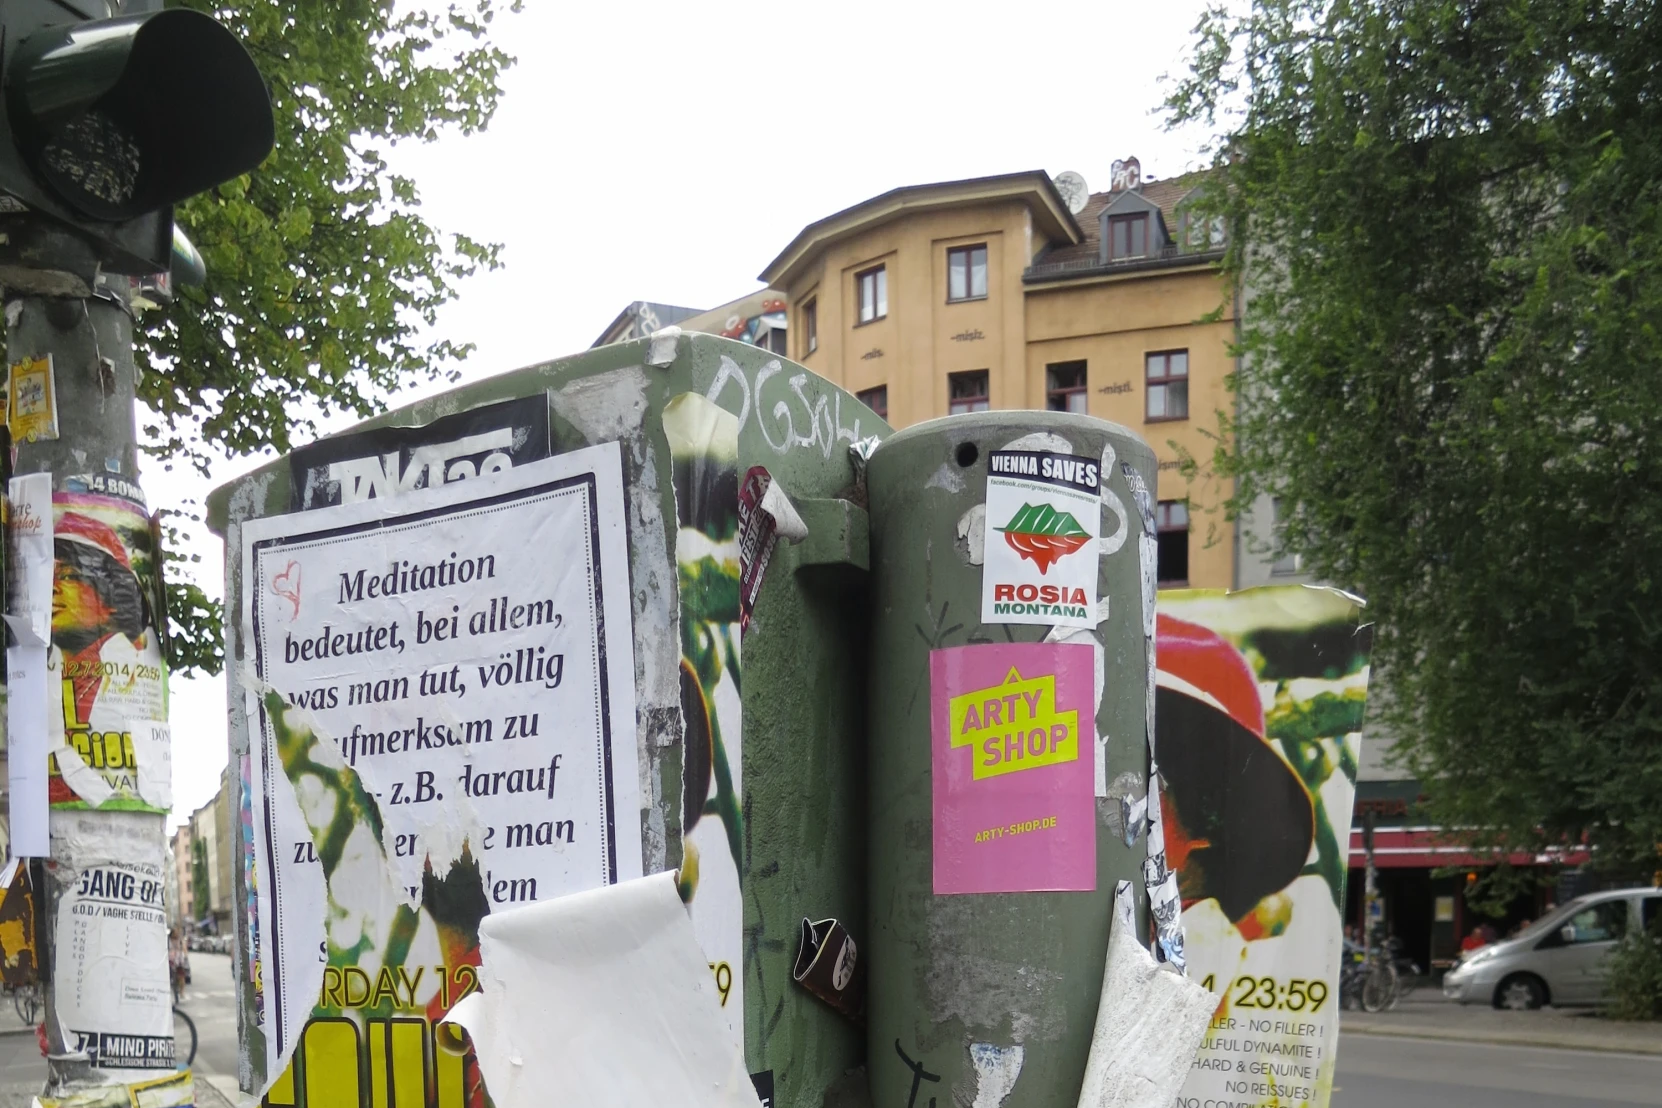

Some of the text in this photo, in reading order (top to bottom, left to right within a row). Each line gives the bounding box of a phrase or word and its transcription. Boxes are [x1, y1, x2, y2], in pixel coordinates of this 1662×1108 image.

[991, 455, 1038, 476] VIENNA
[1042, 457, 1098, 488] SAVES
[337, 552, 495, 604] Meditation
[993, 602, 1087, 619] MONTANA
[284, 598, 563, 664] bedeutet, bei allem,
[289, 646, 564, 712] was man tut, völlig
[961, 688, 1044, 735] ARTY
[334, 710, 539, 766] ufmerksam zu
[982, 725, 1069, 767] SHOP
[390, 771, 444, 805] z.B.
[505, 819, 575, 848] man
[974, 815, 1057, 844] ARTY-SHOP.DE
[1235, 975, 1329, 1014] 23:59
[1249, 1019, 1272, 1034] NO
[1274, 1021, 1316, 1037] FILLER
[106, 1036, 145, 1058] MIND
[1243, 1039, 1313, 1059] DYNAMITE
[1236, 1060, 1246, 1073] &
[1249, 1061, 1312, 1080] GENUINE
[1225, 1080, 1248, 1094] NO
[1250, 1082, 1309, 1101] REISSUES
